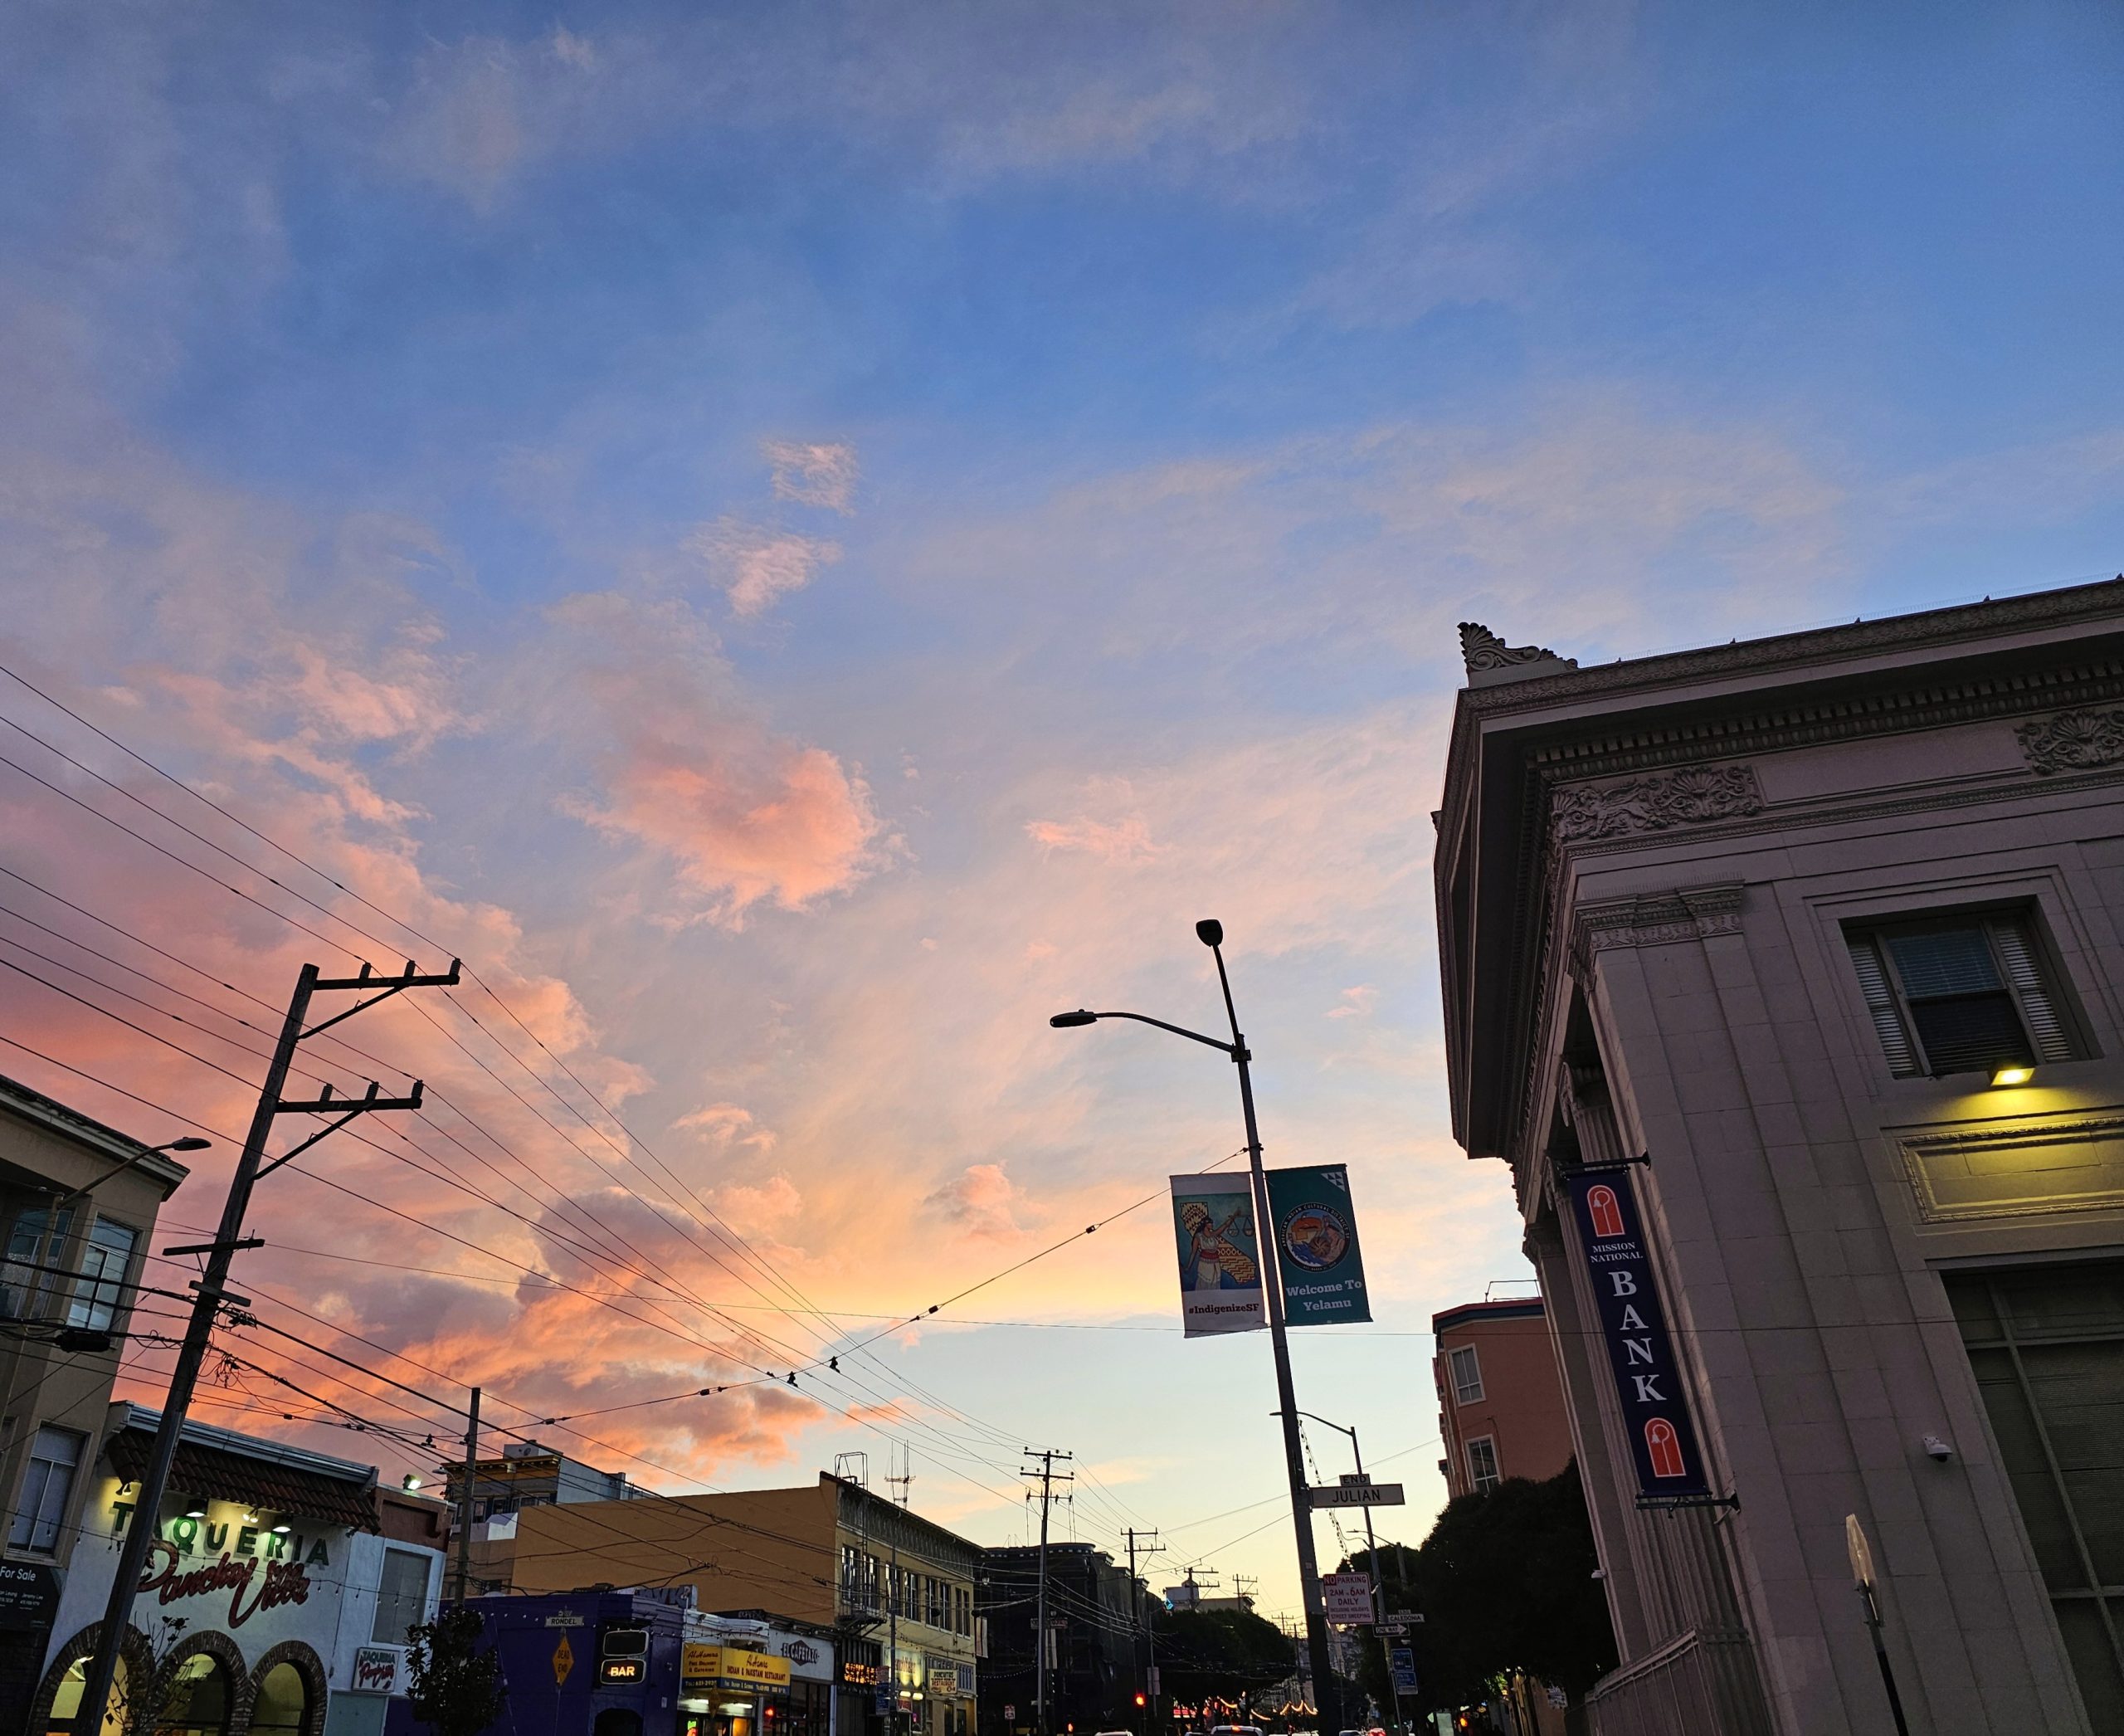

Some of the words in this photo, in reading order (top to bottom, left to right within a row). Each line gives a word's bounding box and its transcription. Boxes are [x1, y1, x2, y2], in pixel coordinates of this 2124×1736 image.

[1592, 1241, 1636, 1254] MISSION
[1590, 1251, 1644, 1264] NATIONAL
[1287, 1283, 1342, 1297] Welcome
[1345, 1280, 1362, 1290] To
[1189, 1303, 1259, 1315] #IndigenizeSF
[1303, 1299, 1352, 1312] Yelamu
[1608, 1270, 1667, 1402] BANK
[1342, 1475, 1367, 1485] END
[1332, 1489, 1381, 1503] JULIAN
[109, 1501, 329, 1567] TQUERIA
[0, 1566, 16, 1578] For
[17, 1568, 37, 1582] Sale
[1324, 1575, 1336, 1584] NO
[1337, 1575, 1366, 1584] PARKING
[1329, 1588, 1344, 1597] 2AM
[1349, 1587, 1366, 1597] 6AM
[1337, 1597, 1359, 1606] DAILY
[558, 1649, 570, 1660] DEAD
[558, 1663, 568, 1673] END
[610, 1666, 635, 1677] BAR
[727, 1665, 740, 1675] INDIAN
[764, 1670, 786, 1681] RESTAURANT
